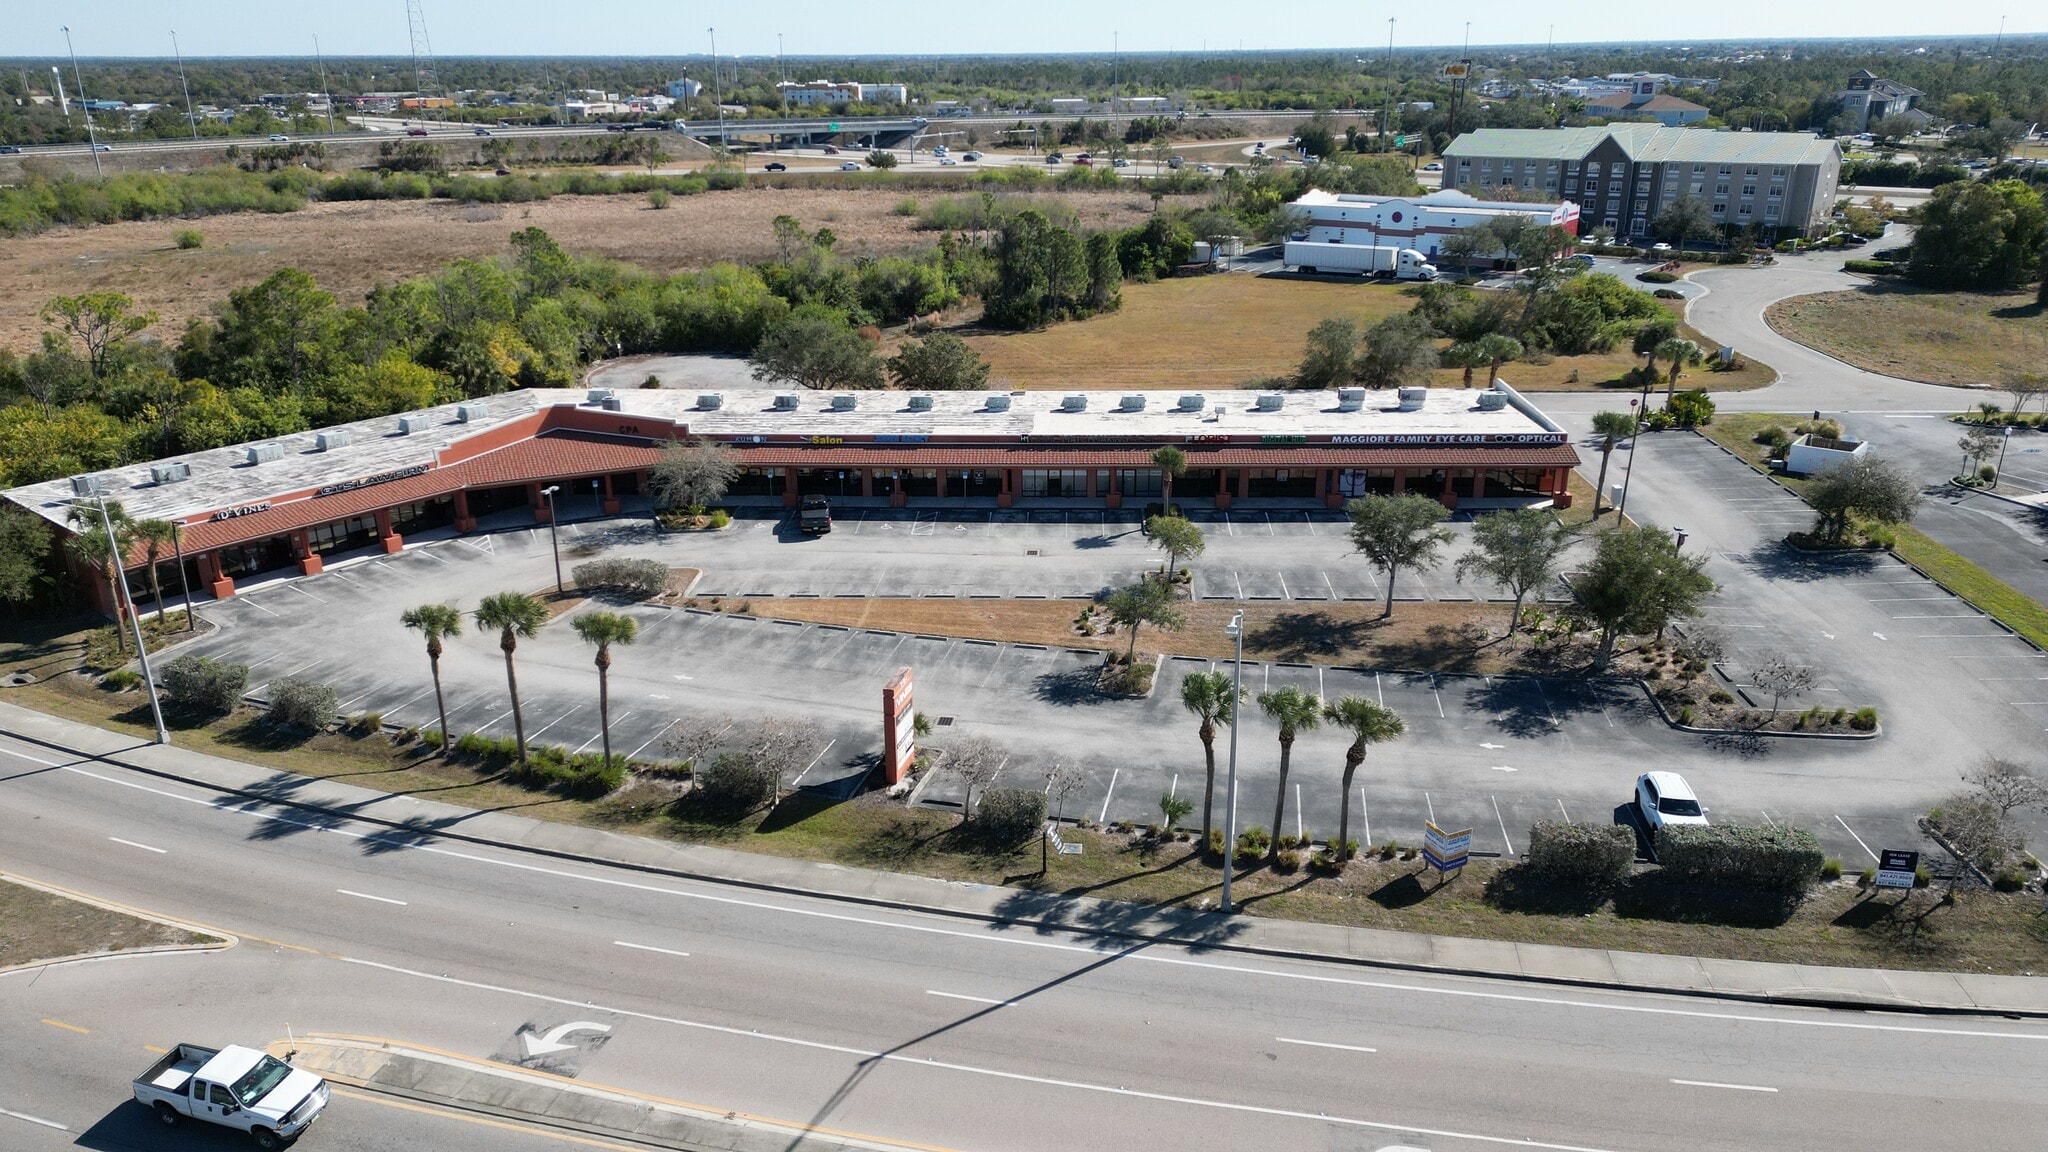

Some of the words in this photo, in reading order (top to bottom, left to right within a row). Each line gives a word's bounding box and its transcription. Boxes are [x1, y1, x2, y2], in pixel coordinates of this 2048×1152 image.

[619, 426, 640, 434] CPA
[735, 435, 767, 443] KUMON
[811, 435, 843, 445] Salon
[1185, 434, 1233, 444] FLORIST
[1331, 435, 1391, 443] MAGGIORE
[1393, 435, 1433, 443] FAMILY
[1435, 435, 1456, 443] EYE
[1458, 435, 1488, 443] CARE
[1518, 435, 1563, 443] OPTICAL
[356, 473, 395, 488] LAW
[393, 463, 430, 478] FIRM
